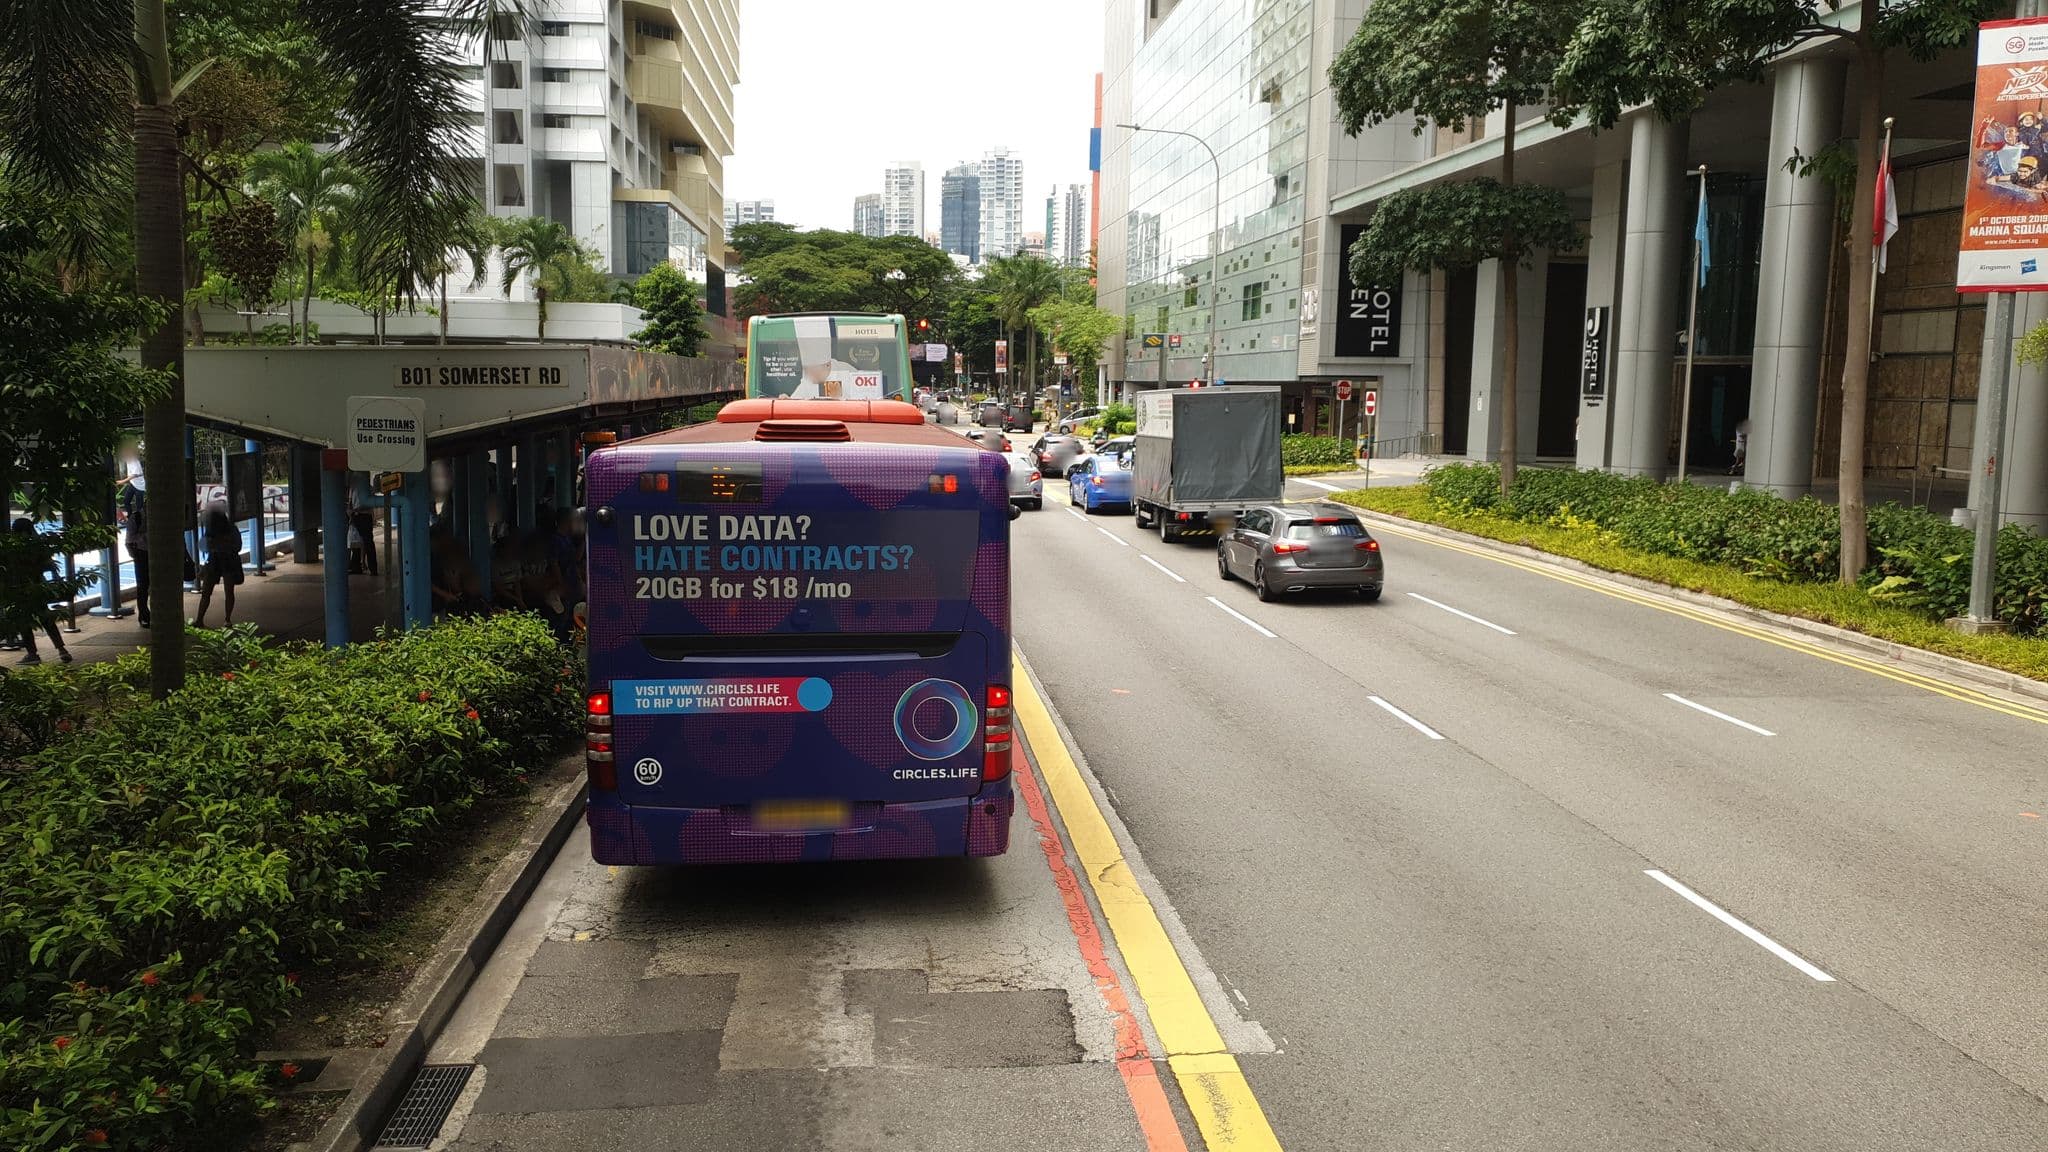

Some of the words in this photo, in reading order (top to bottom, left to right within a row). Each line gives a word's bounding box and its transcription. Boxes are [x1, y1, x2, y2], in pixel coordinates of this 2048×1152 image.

[2008, 41, 2022, 49] SG
[2006, 73, 2047, 89] NERF
[1991, 216, 2027, 225] OCTOBER
[2029, 214, 2048, 223] 2019
[1970, 225, 2010, 237] MARINA
[2013, 224, 2048, 235] SQUAR
[1370, 285, 1391, 352] OTEL
[1584, 340, 1592, 369] JEN
[1590, 339, 1599, 391] HOTEL
[439, 367, 531, 385] SOMERSET
[539, 367, 561, 385] RD
[855, 376, 877, 387] OKI
[1337, 386, 1351, 394] STOP
[357, 418, 415, 430] PEDESTRIANS
[357, 433, 373, 443] Use
[377, 434, 416, 446] Crossing
[634, 515, 709, 541] LOVE
[719, 515, 812, 541] DATA?
[635, 546, 711, 571] HATE
[720, 545, 914, 571] CONTRACTS?
[635, 577, 701, 599] 20GB
[710, 577, 745, 599] for
[752, 576, 798, 600] $18
[805, 577, 851, 599] /mo
[635, 685, 666, 697] VISIT
[668, 683, 780, 696] WWW.CIRCLES.LIFE
[635, 698, 650, 709] TO
[653, 698, 673, 709] RIP
[677, 697, 693, 708] UP
[696, 697, 725, 708] THAT
[728, 695, 792, 707] CONTRACT.
[639, 762, 657, 776] 60
[893, 768, 978, 779] CIRCLES.LIFE
